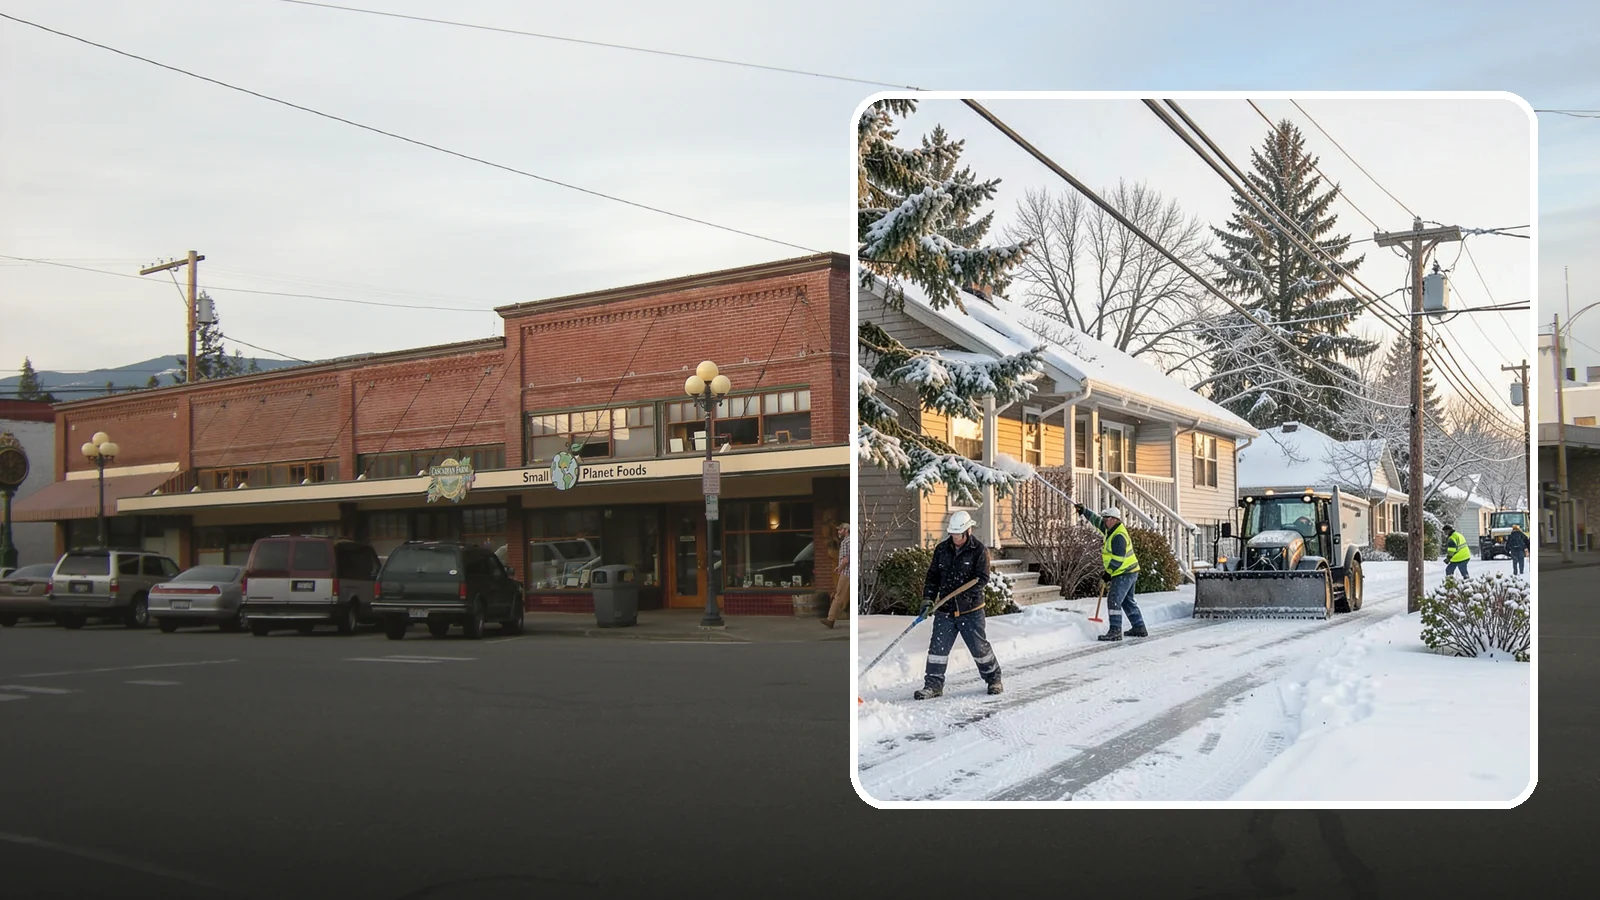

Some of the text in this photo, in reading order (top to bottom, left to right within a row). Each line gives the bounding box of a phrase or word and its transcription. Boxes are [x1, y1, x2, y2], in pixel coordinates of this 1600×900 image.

[431, 466, 455, 475] CASCADIAN
[523, 464, 647, 483] Small Planet Foods
